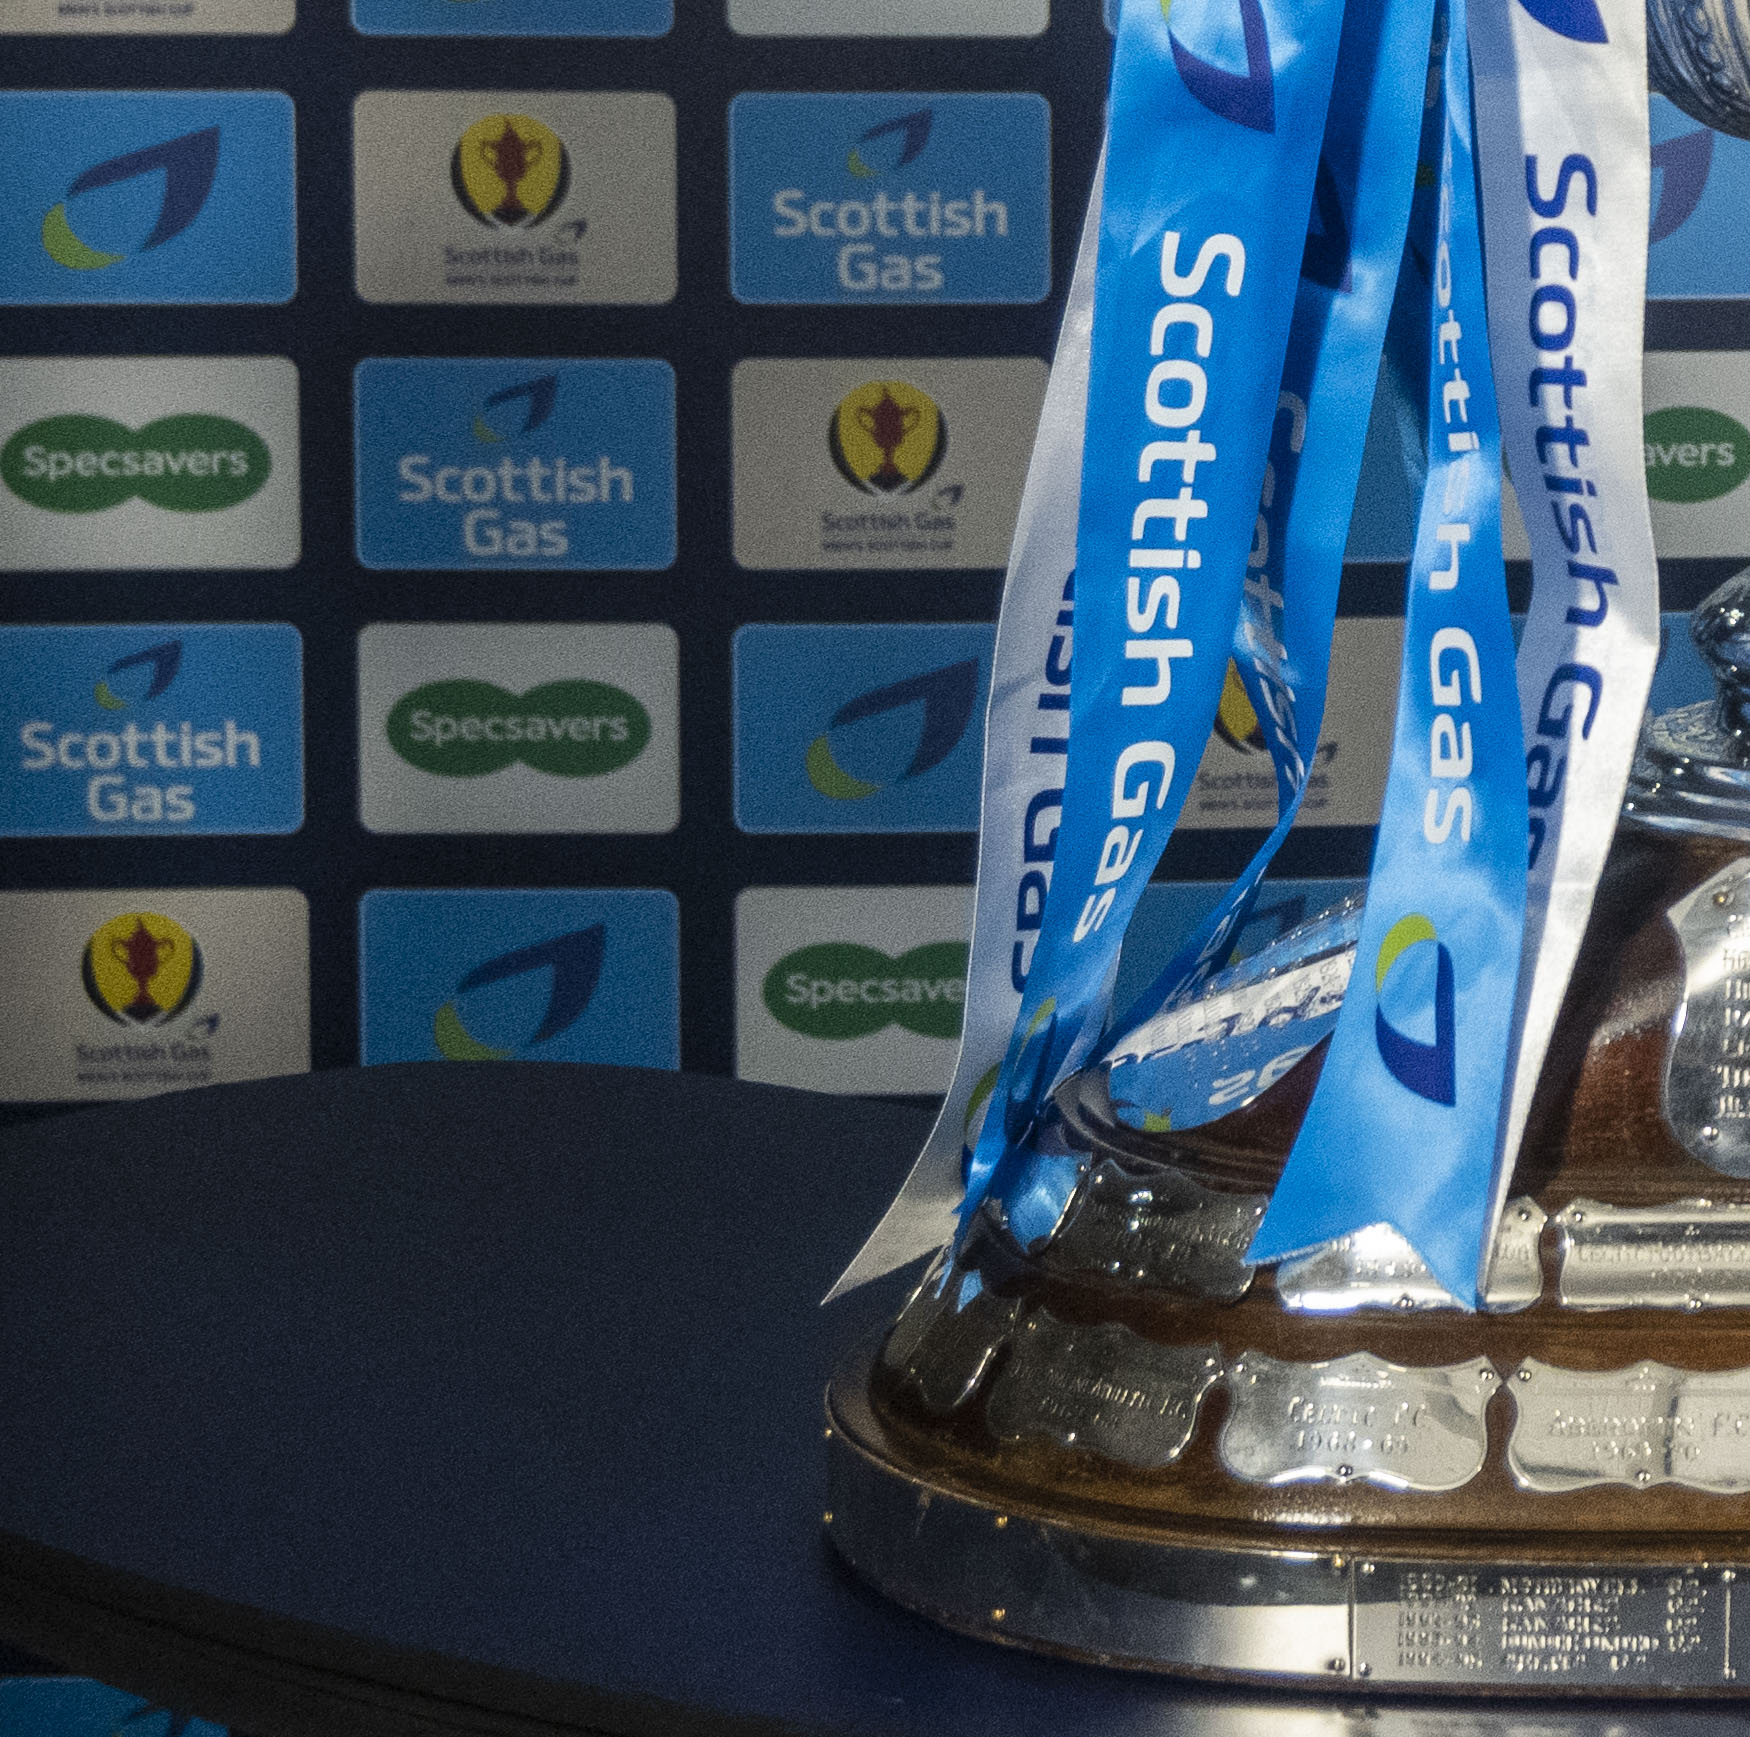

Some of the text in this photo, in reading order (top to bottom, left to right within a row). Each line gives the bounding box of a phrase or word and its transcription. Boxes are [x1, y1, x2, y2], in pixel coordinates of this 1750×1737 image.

[773, 189, 1007, 237] Scottish
[838, 243, 943, 291] Gas
[1526, 153, 1620, 628] Scottish
[24, 446, 248, 481] Specsavers
[399, 455, 633, 503] Scottish
[464, 508, 568, 556] Gas
[1076, 231, 1245, 943] Scottish Gas
[22, 720, 260, 769] Scottish
[411, 710, 629, 746] Specsavers
[1423, 628, 1482, 844] Gas
[88, 774, 195, 822] Gas
[786, 972, 963, 1007] Specsave
